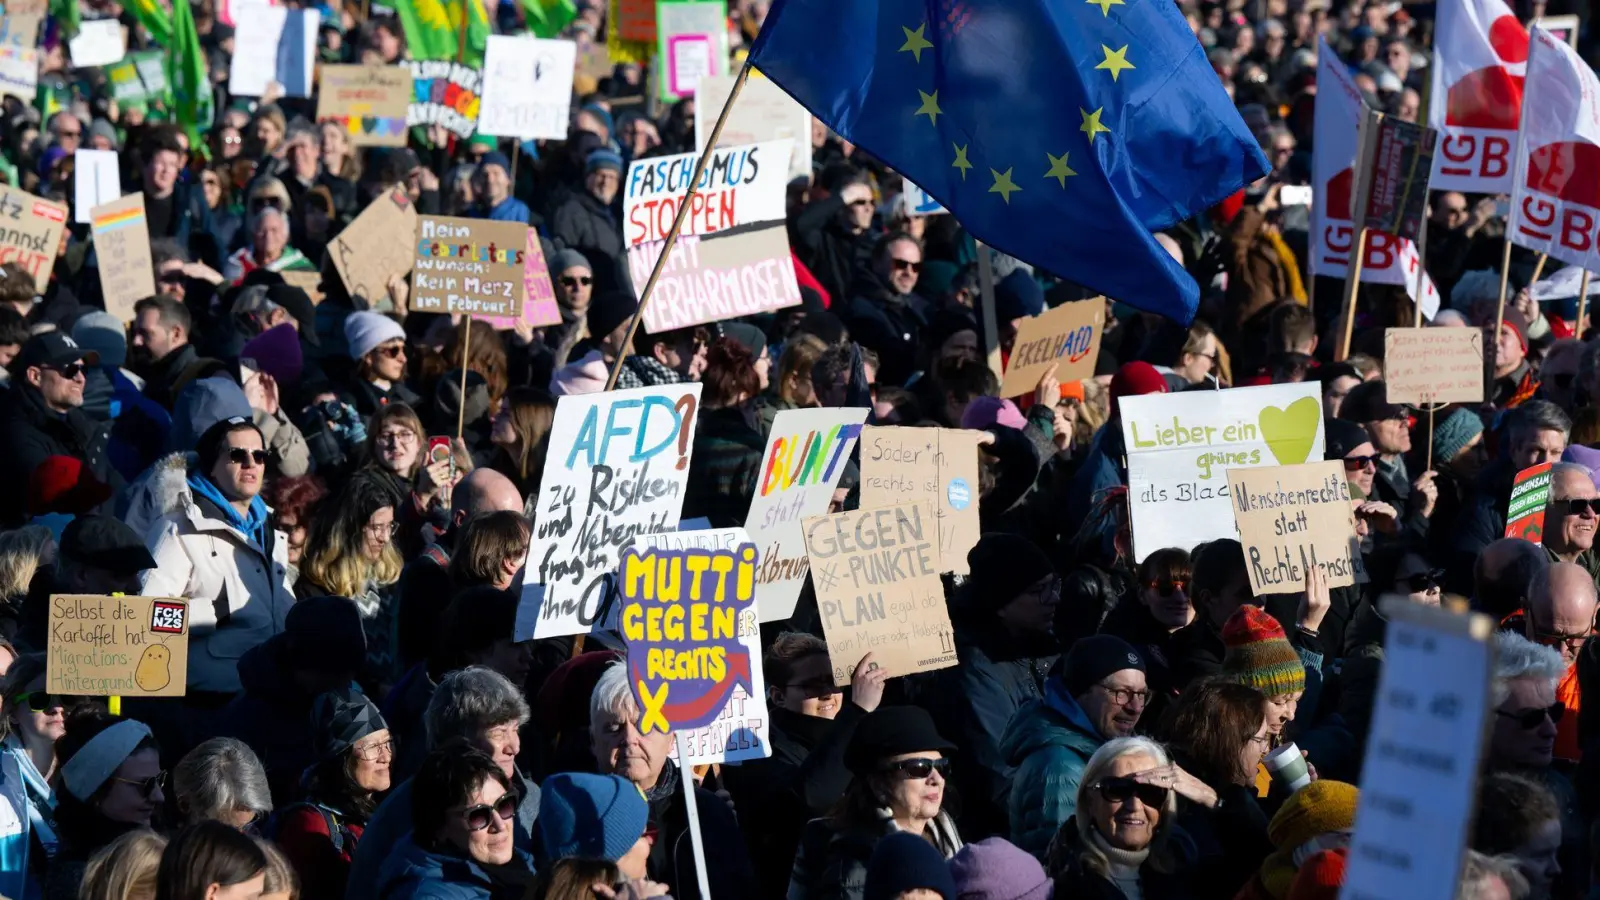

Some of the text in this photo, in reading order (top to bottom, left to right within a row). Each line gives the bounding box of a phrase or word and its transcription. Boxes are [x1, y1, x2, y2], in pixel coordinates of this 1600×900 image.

[421, 220, 470, 239] Mein
[417, 239, 524, 267] Geburtstags
[415, 273, 513, 297] Kein Merz
[416, 292, 441, 308] im
[447, 293, 515, 316] Februar!
[565, 393, 697, 470] AFD?
[1130, 416, 1257, 448] Lieber ein
[760, 423, 865, 497] BUNT
[1196, 448, 1261, 480] grünes
[548, 459, 680, 516] zu Risiken
[866, 474, 914, 493] rechts
[1141, 483, 1232, 503] als Blac
[1235, 474, 1350, 512] Menschenrechte
[1511, 473, 1550, 501] GEMEINSAM
[538, 506, 573, 539] und
[807, 504, 924, 559] GEGEN
[1274, 510, 1308, 536] statt
[1249, 534, 1303, 589] Rechte
[52, 597, 137, 620] Selbst die
[154, 607, 184, 620] FCK
[622, 603, 736, 642] GEGEN
[821, 591, 938, 630] PLAN egal ob
[52, 622, 148, 648] Kartoffel hat
[152, 617, 183, 629] NZS
[832, 638, 854, 654] von
[855, 630, 888, 649] Merz
[646, 646, 727, 684] RECHTS
[51, 668, 134, 695] Hintergrund
